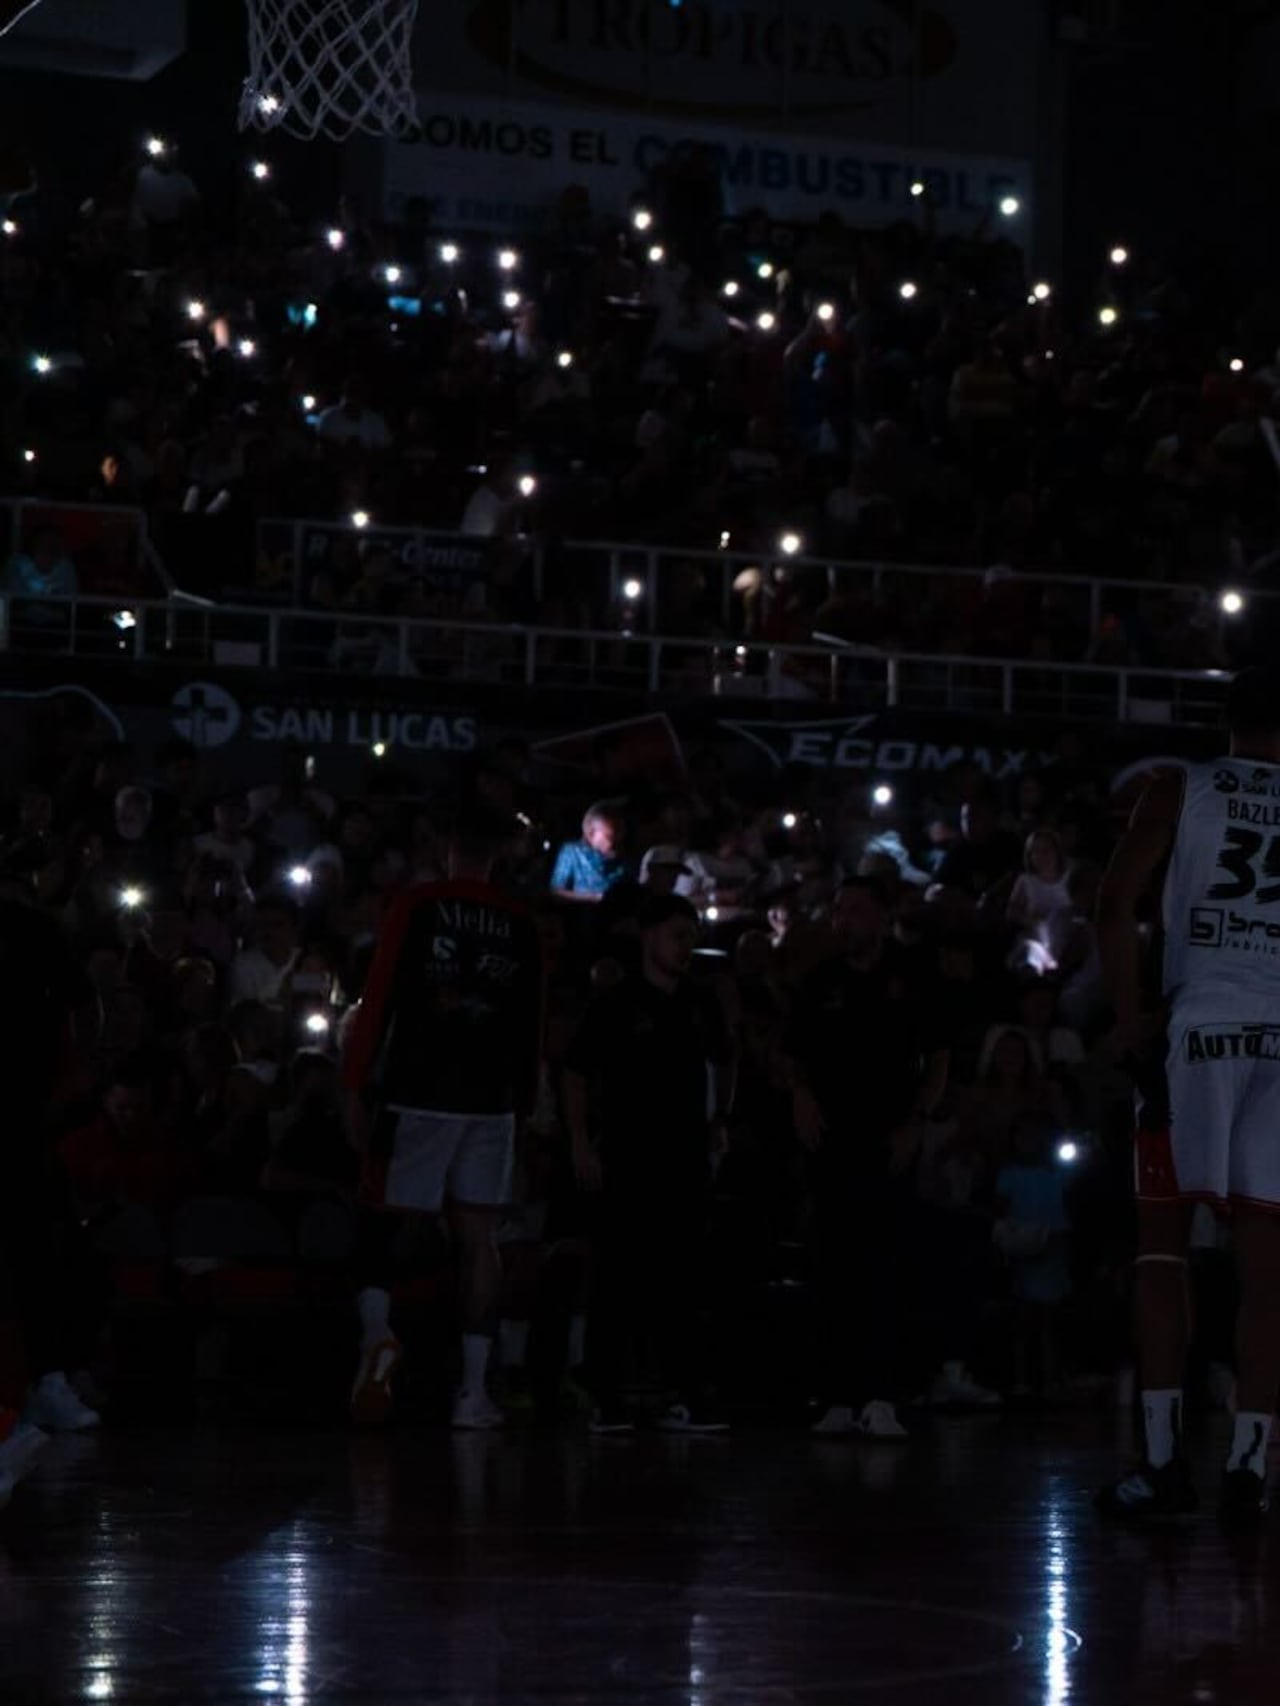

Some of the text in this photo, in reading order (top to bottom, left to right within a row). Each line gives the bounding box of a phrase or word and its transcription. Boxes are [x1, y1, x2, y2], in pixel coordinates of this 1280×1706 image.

[569, 128, 619, 166] EL
[251, 706, 478, 751] SAN LUCAS
